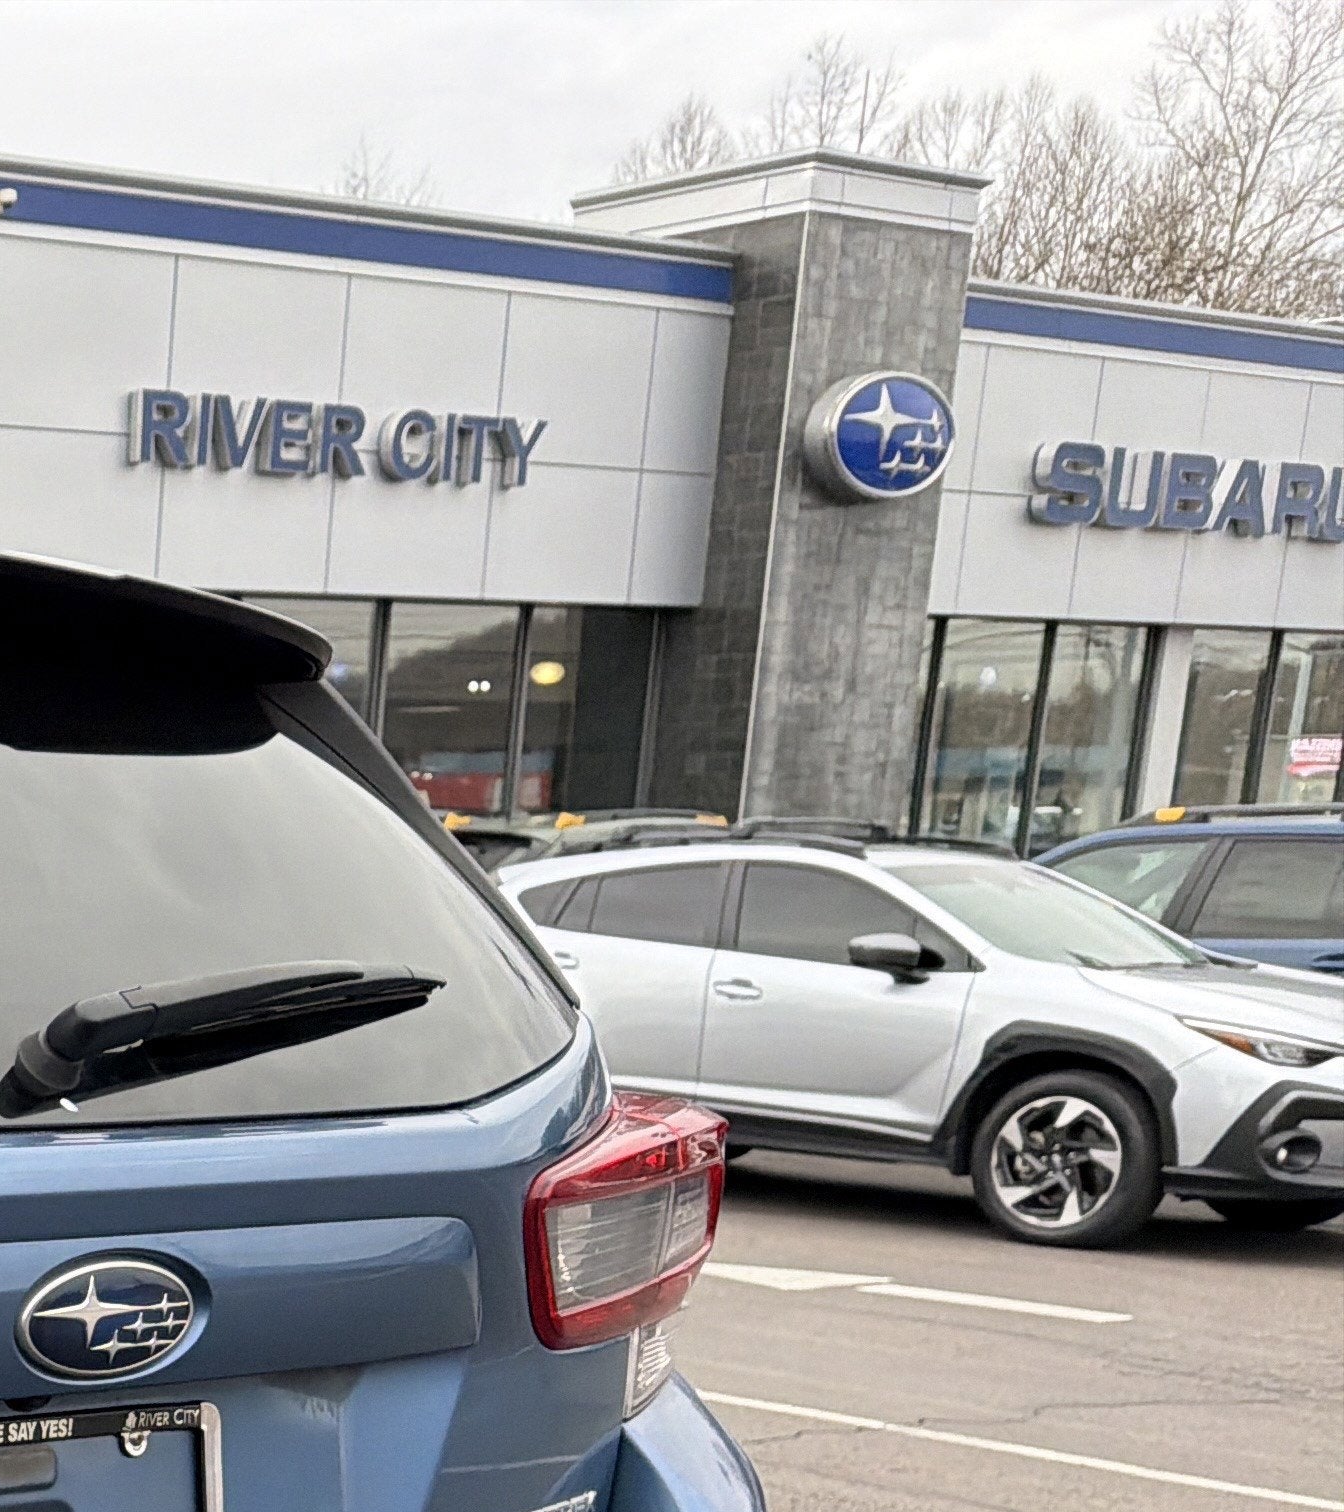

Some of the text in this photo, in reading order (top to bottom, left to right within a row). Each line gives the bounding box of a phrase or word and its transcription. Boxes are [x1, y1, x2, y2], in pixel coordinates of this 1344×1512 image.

[128, 388, 549, 490] RIVER CITY
[7, 1420, 38, 1443] SAY
[40, 1417, 74, 1440] YES!
[137, 1408, 200, 1428] RIVER CITY
